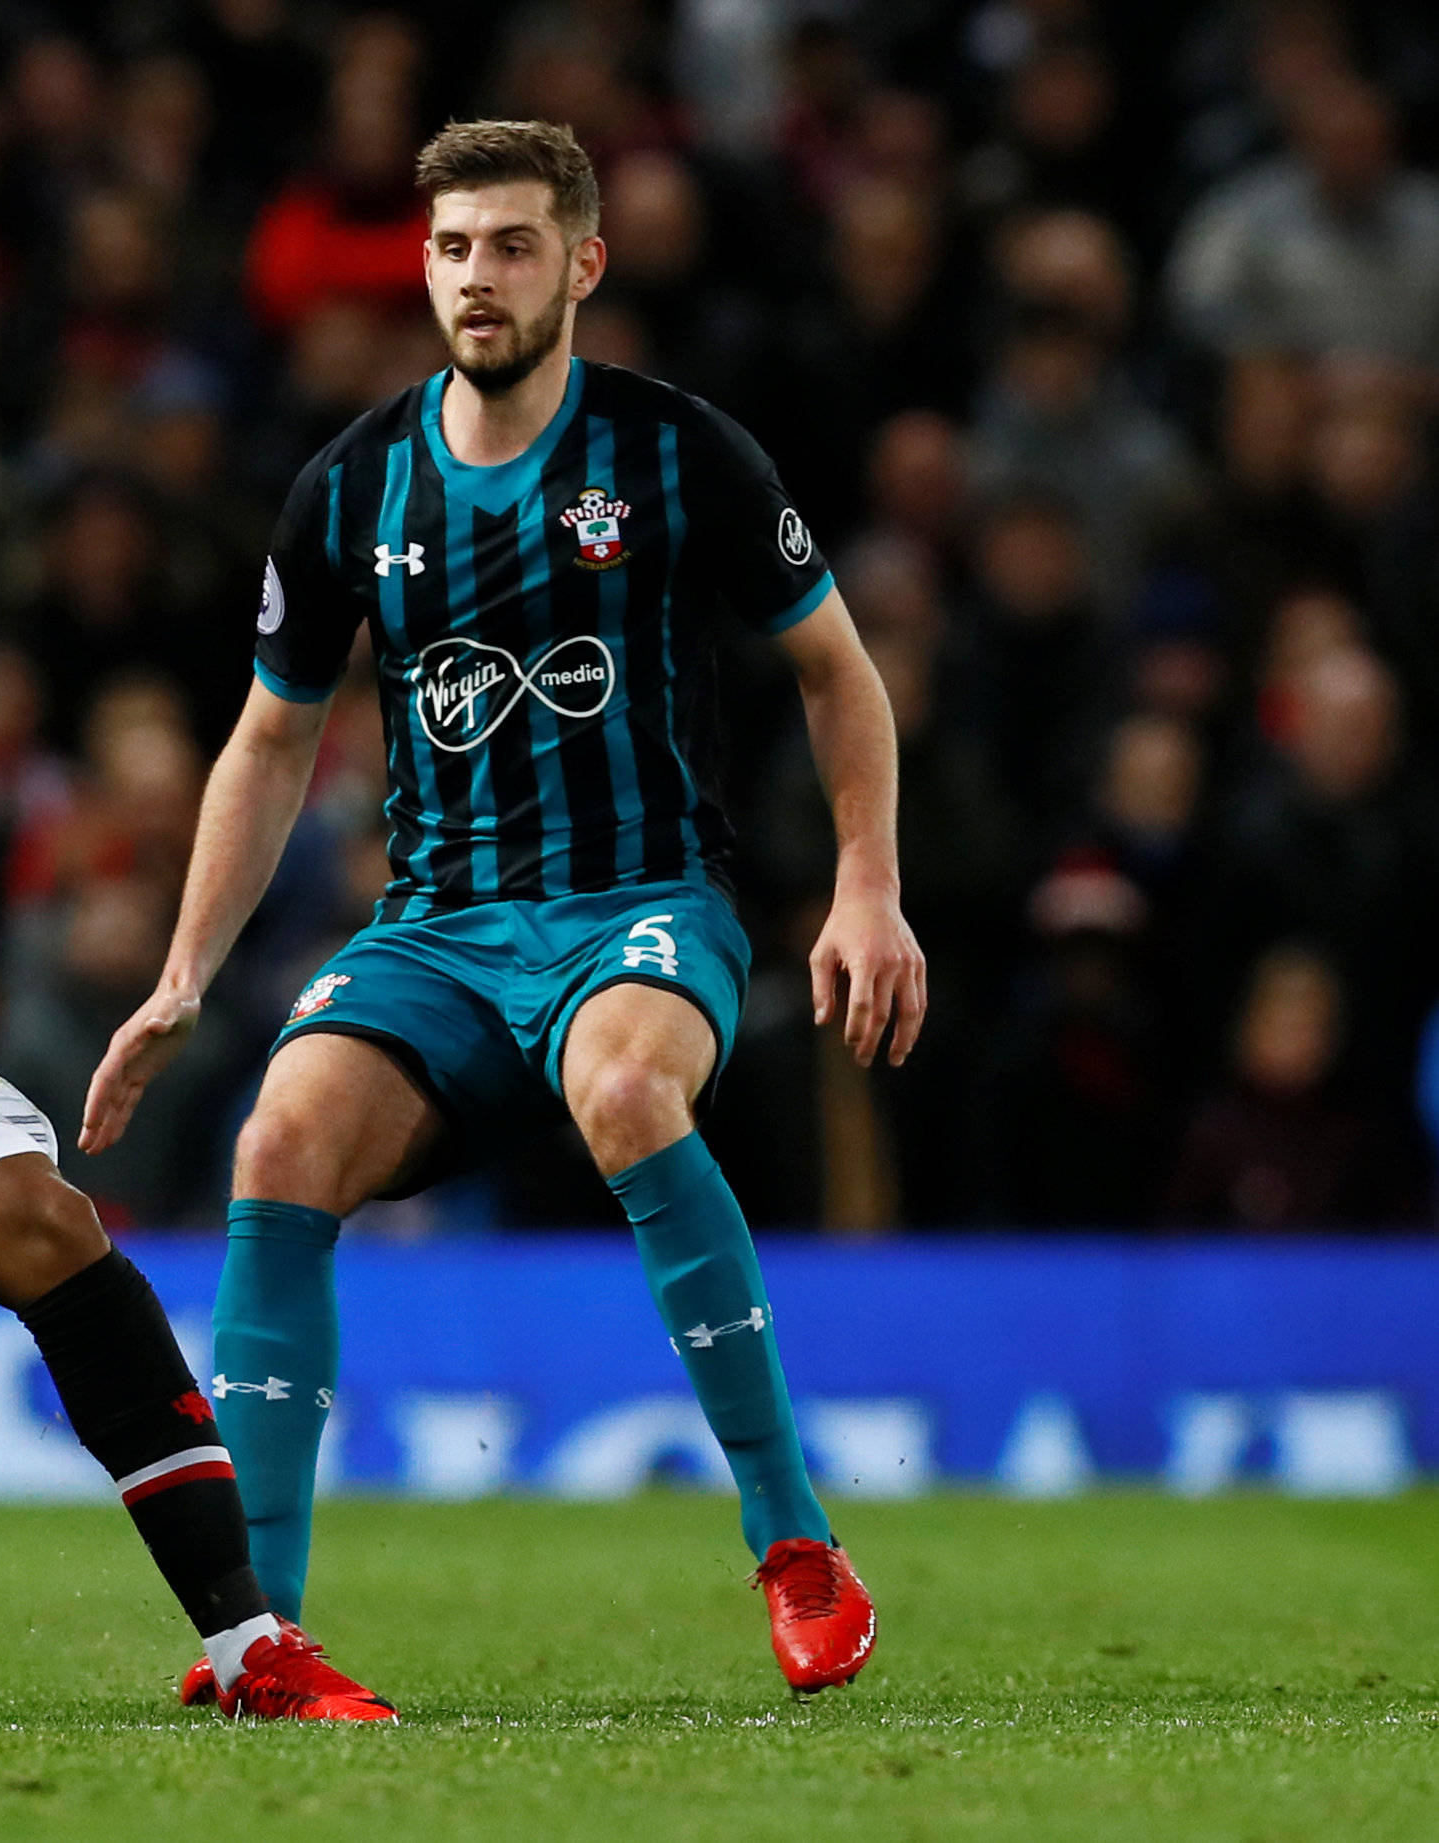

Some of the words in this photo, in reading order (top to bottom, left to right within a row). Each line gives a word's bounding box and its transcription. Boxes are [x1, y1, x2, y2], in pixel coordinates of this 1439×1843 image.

[426, 656, 506, 729] Virgin
[541, 664, 605, 686] media
[623, 914, 676, 957] 5
